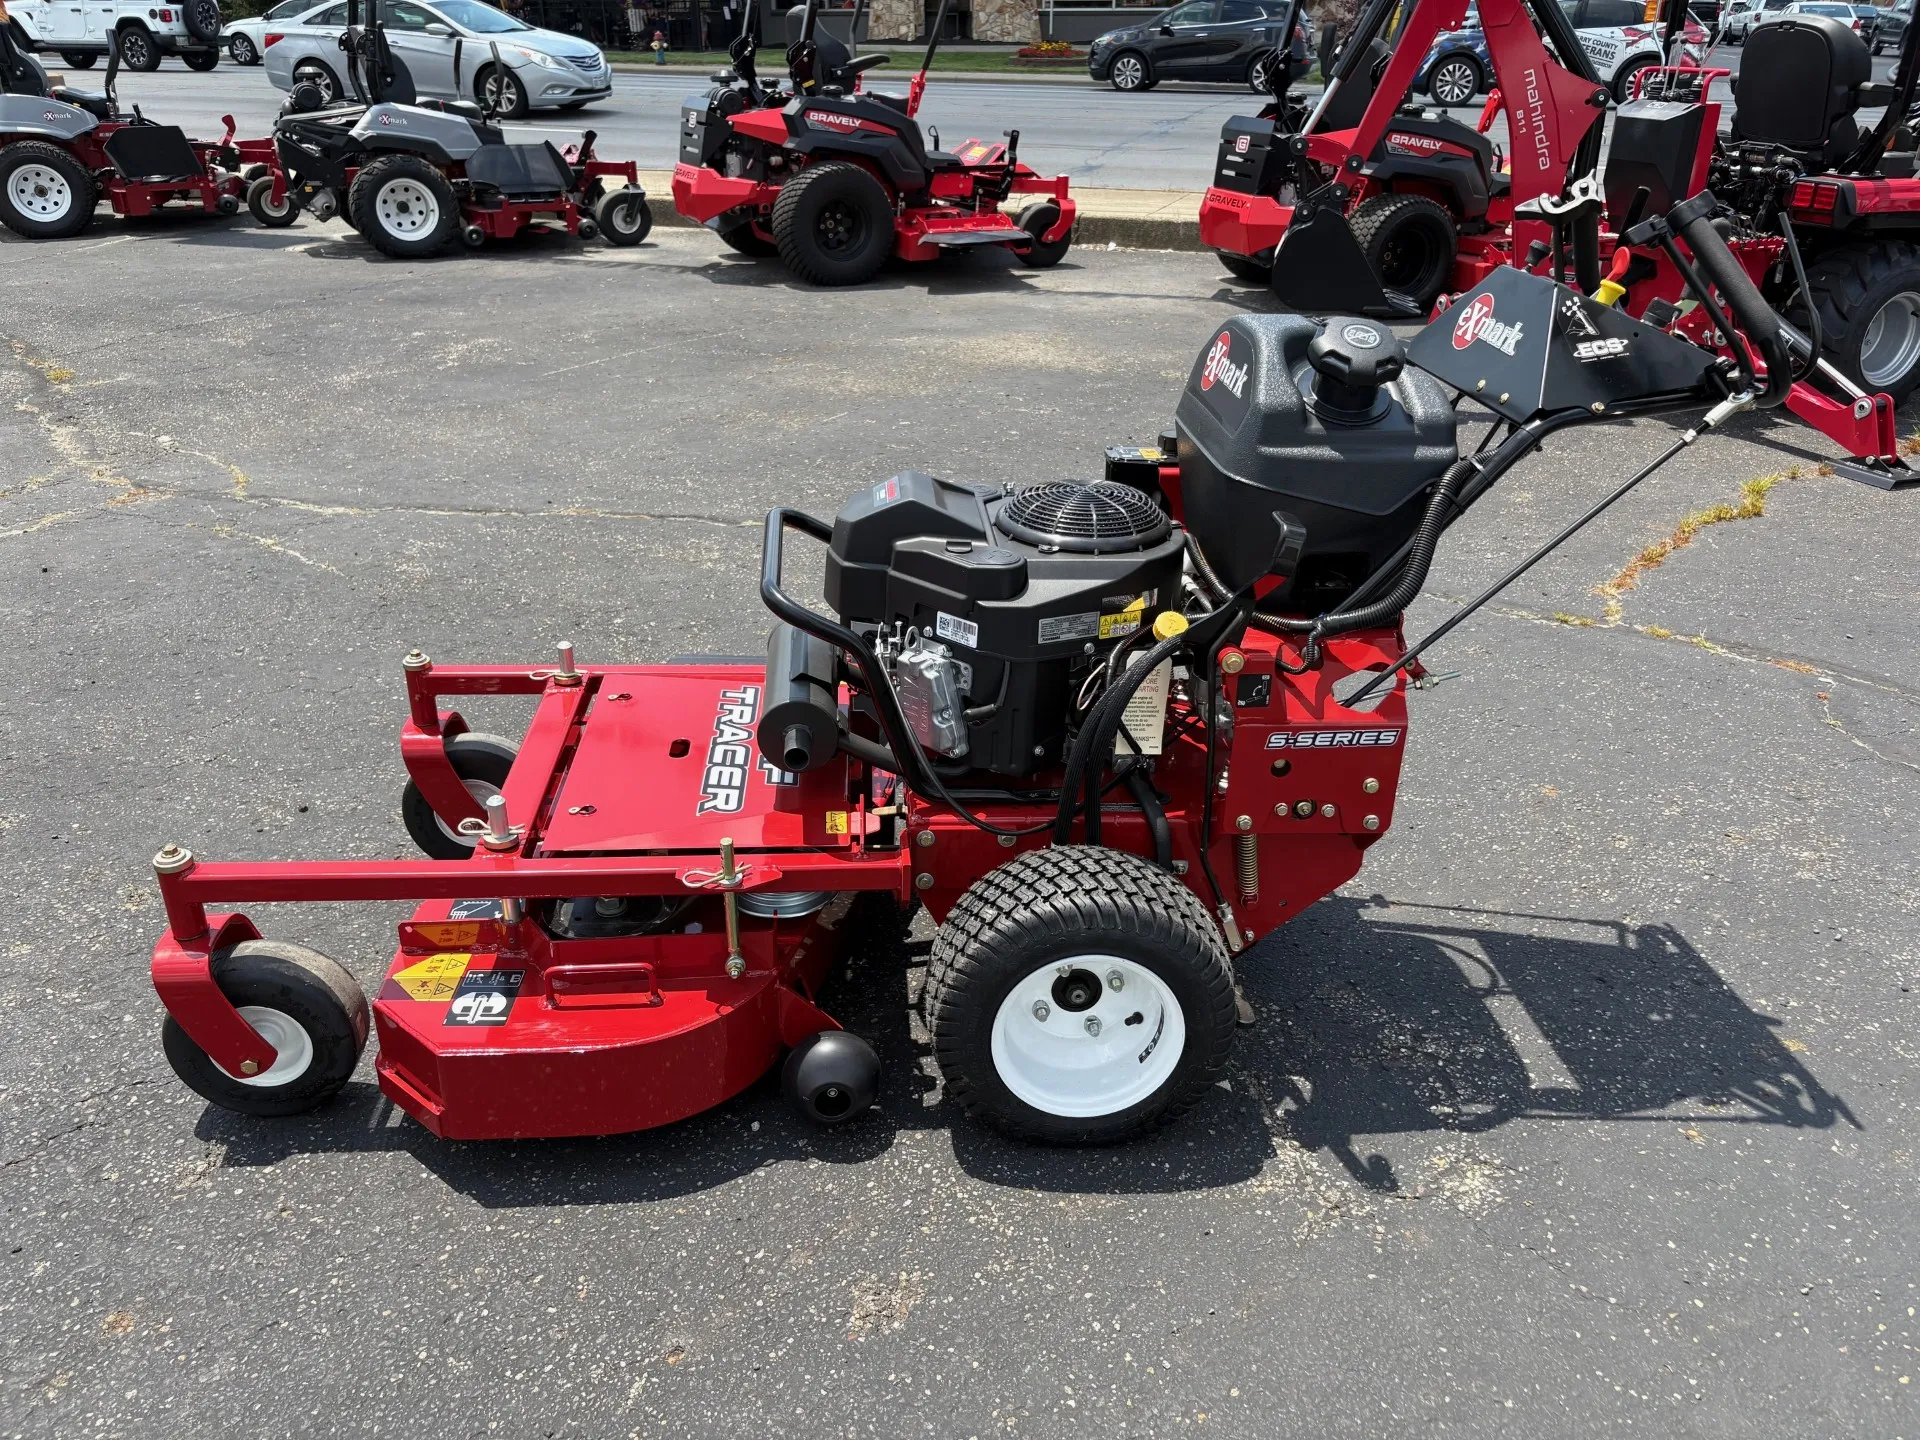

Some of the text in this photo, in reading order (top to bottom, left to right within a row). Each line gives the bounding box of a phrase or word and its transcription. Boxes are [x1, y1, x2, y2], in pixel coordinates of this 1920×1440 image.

[1579, 35, 1619, 50] RRY COUNTY
[1585, 44, 1616, 60] ERANS
[809, 112, 862, 127] GRAVELY
[1524, 68, 1550, 170] mahindra
[1390, 134, 1443, 150] GRAVELY
[1208, 194, 1247, 209] GRAVELY
[1576, 338, 1624, 358] ECS
[1266, 730, 1400, 748] S-SERIES
[698, 686, 760, 814] TRACER
